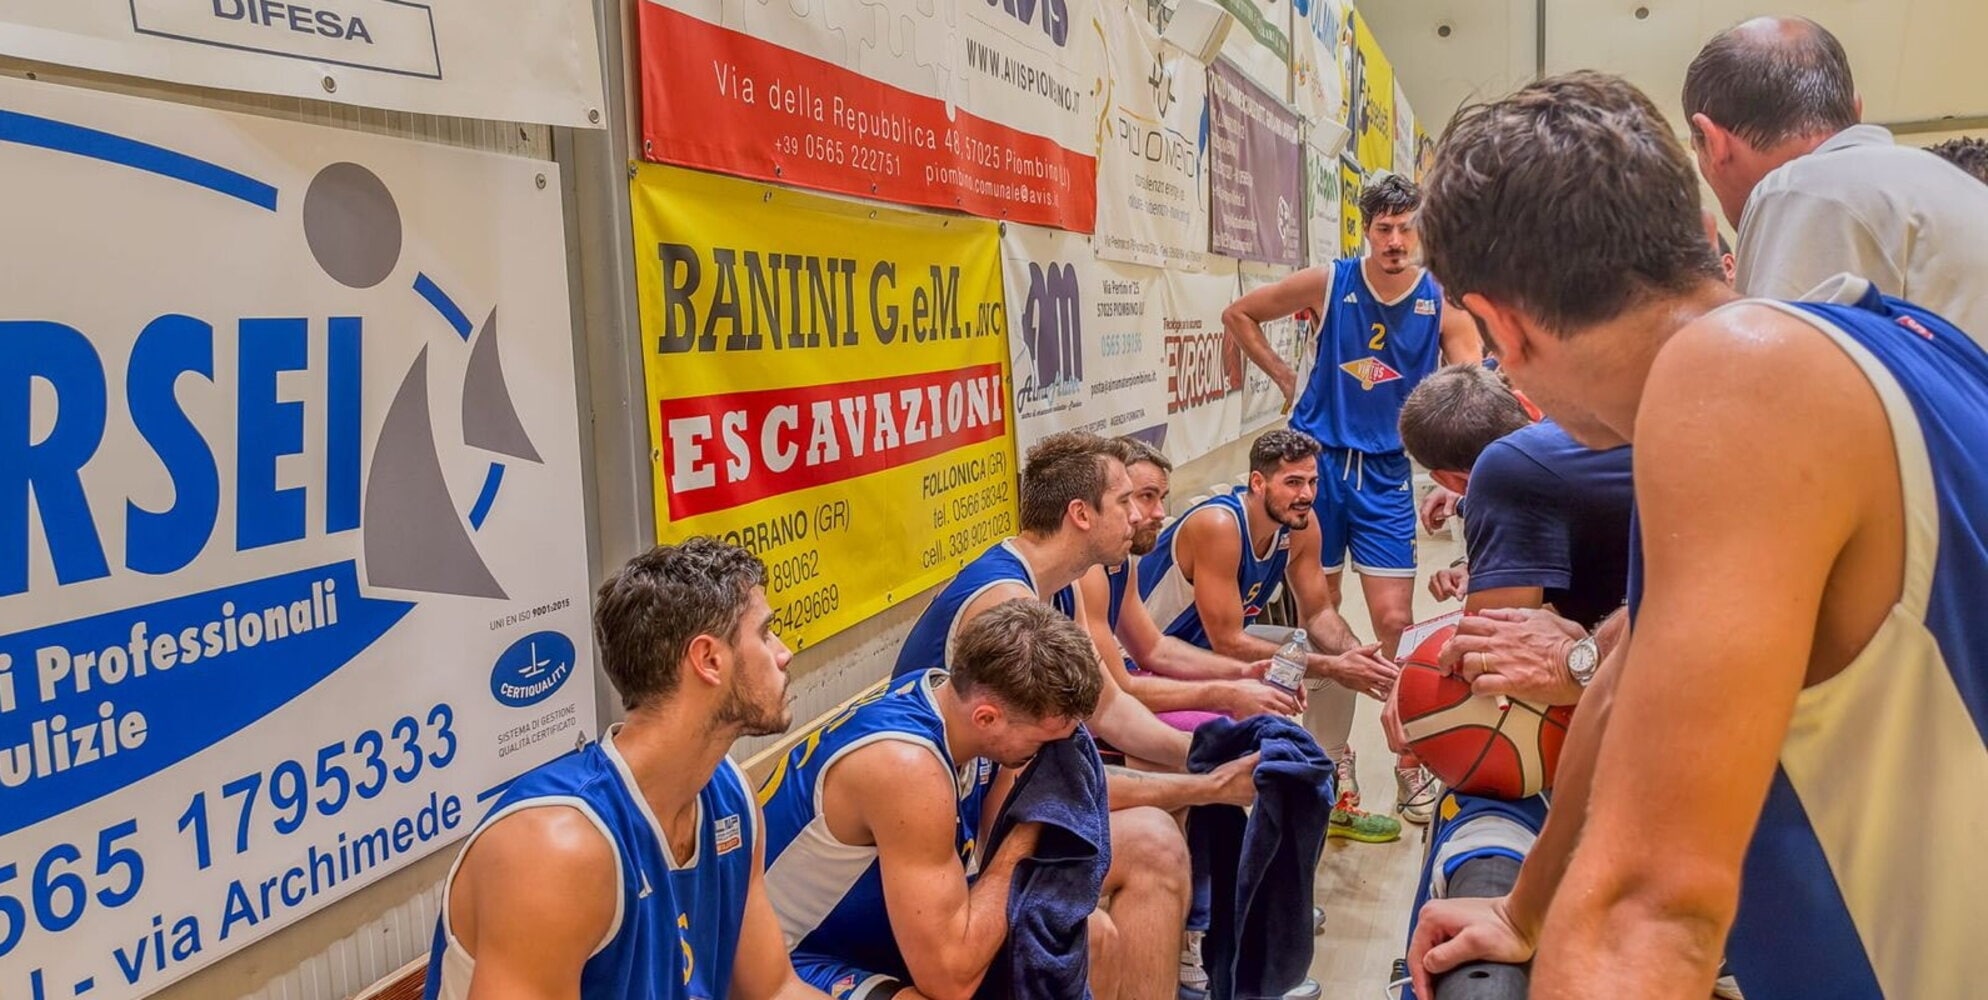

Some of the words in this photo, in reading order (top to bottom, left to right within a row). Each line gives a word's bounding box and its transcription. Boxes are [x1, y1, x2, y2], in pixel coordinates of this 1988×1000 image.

[212, 0, 374, 45] DIFESA
[713, 60, 755, 104] Via
[769, 78, 824, 122] della
[834, 96, 936, 150] Repubblica
[965, 136, 1000, 169] 57025
[774, 135, 798, 155] +39
[805, 134, 844, 165] 0565
[851, 144, 900, 176] 222751
[658, 242, 858, 354] BANINI
[1368, 323, 1387, 351] 2
[668, 374, 1004, 494] ESCAVAZIONI
[923, 458, 986, 501] FOLLONICA
[987, 450, 1008, 477] (GR)
[813, 498, 850, 540] (GR)
[933, 502, 950, 529] tel.
[952, 490, 980, 522] 0566
[922, 539, 946, 568] cell.
[949, 529, 970, 557] 338
[773, 549, 820, 593] 89062
[490, 616, 505, 630] UNI
[506, 611, 518, 627] EN
[519, 609, 531, 622] ISO
[532, 598, 571, 618] 9001:2015
[36, 578, 339, 703] Professionali
[500, 662, 567, 700] CERTIQUALITY
[498, 722, 531, 745] SISTEMA
[532, 718, 541, 730] DI
[541, 703, 577, 725] GESTIONE
[532, 716, 577, 746] CERTIFICATO
[177, 702, 458, 870] 1795333
[113, 914, 203, 985] via
[218, 790, 463, 942] Archimede
